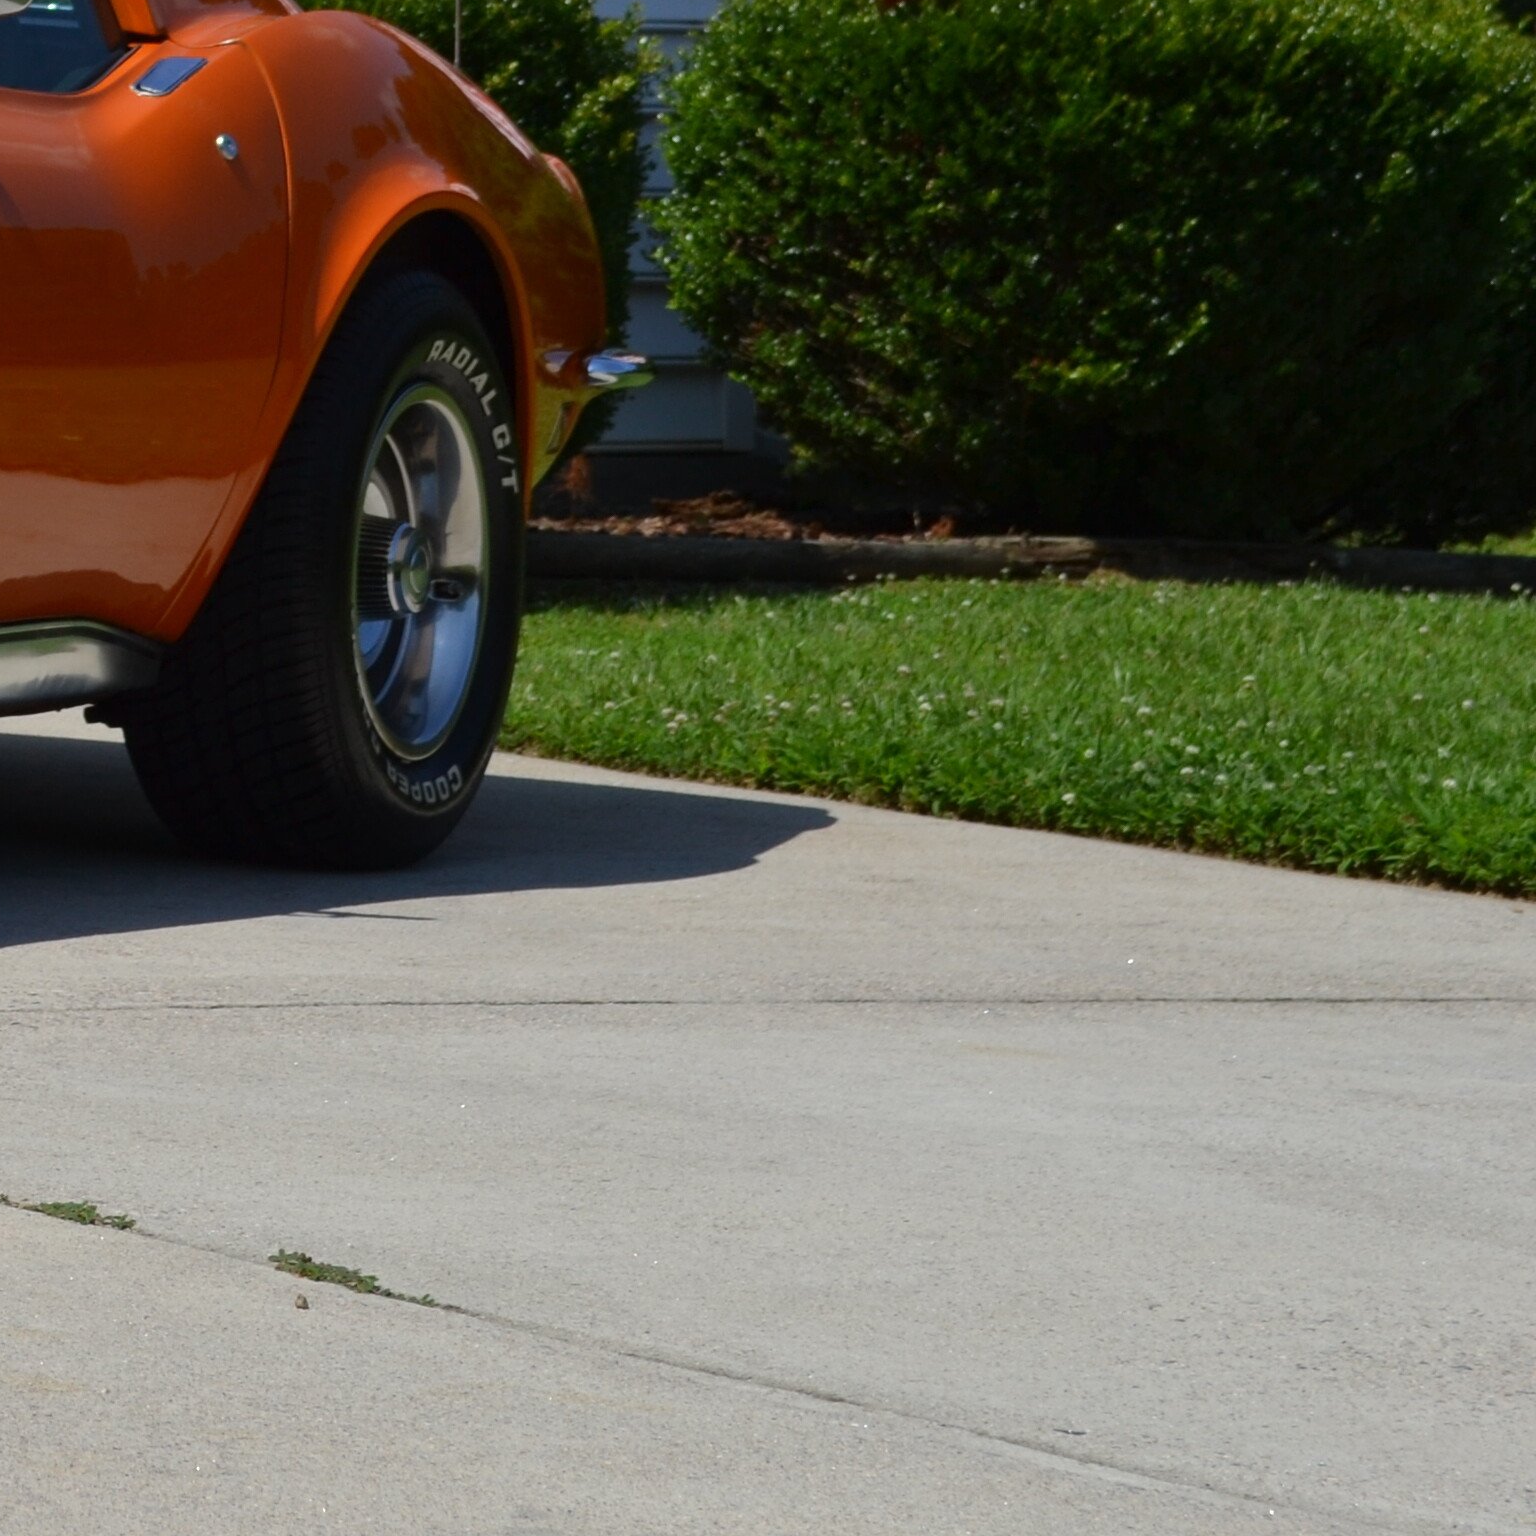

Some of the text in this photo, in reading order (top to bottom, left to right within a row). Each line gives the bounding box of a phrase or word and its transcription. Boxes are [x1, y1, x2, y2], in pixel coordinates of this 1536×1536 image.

[426, 338, 520, 495] RADIAL G/T
[385, 763, 463, 804] COOPER
